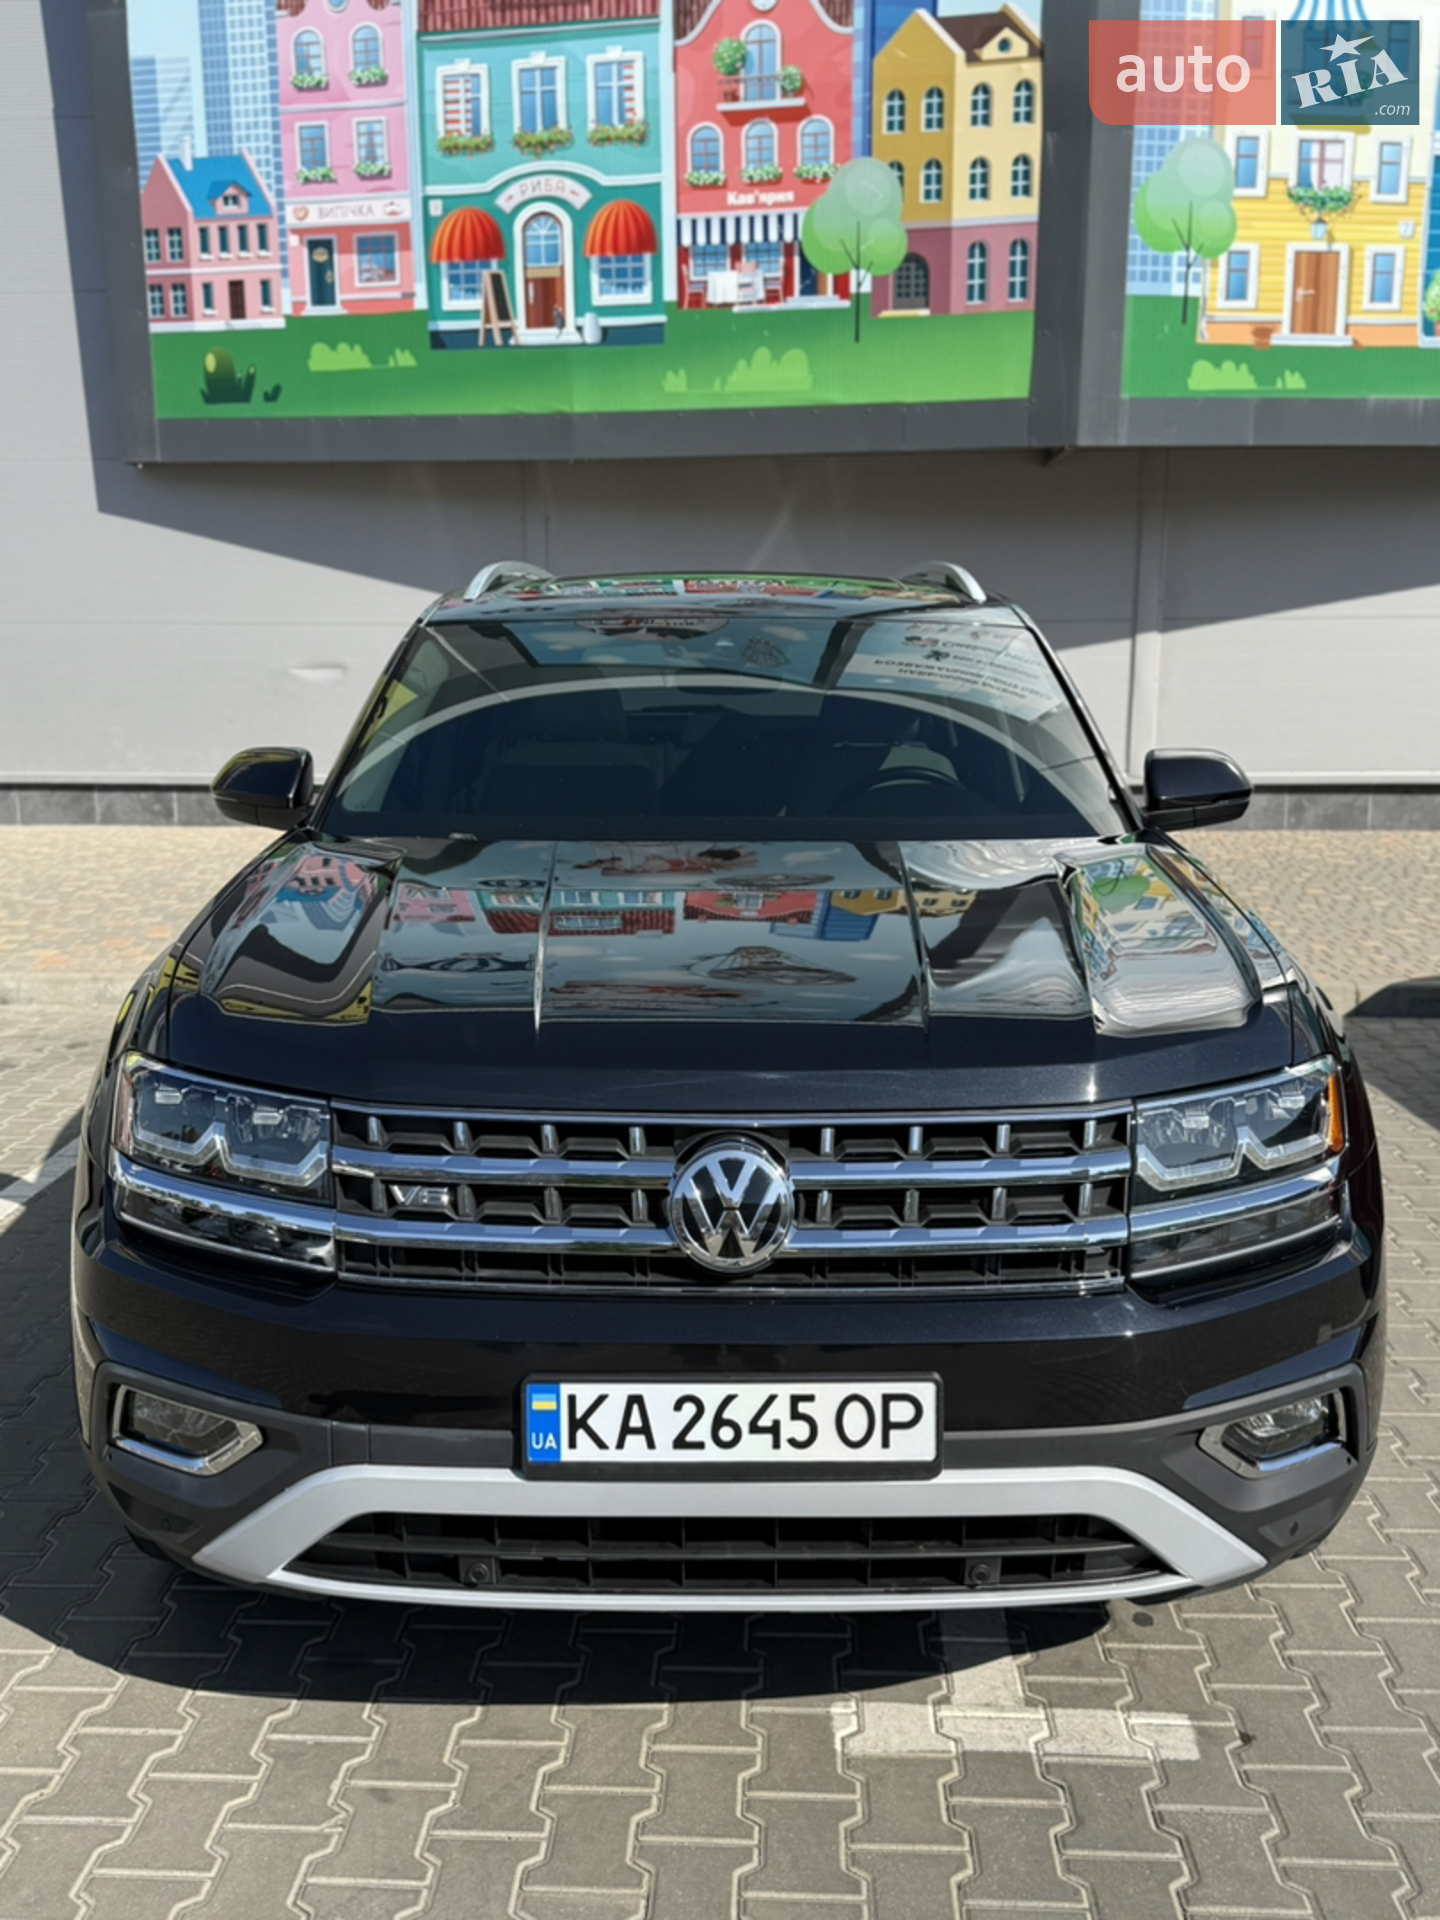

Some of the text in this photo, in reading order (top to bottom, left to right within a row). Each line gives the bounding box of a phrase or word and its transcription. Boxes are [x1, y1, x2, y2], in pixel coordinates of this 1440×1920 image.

[519, 179, 566, 195] РИБА
[317, 204, 375, 219] ВИПІЧКА
[388, 1184, 450, 1206] V6
[566, 1393, 925, 1450] KA 2645 OP
[531, 1432, 558, 1450] UA
